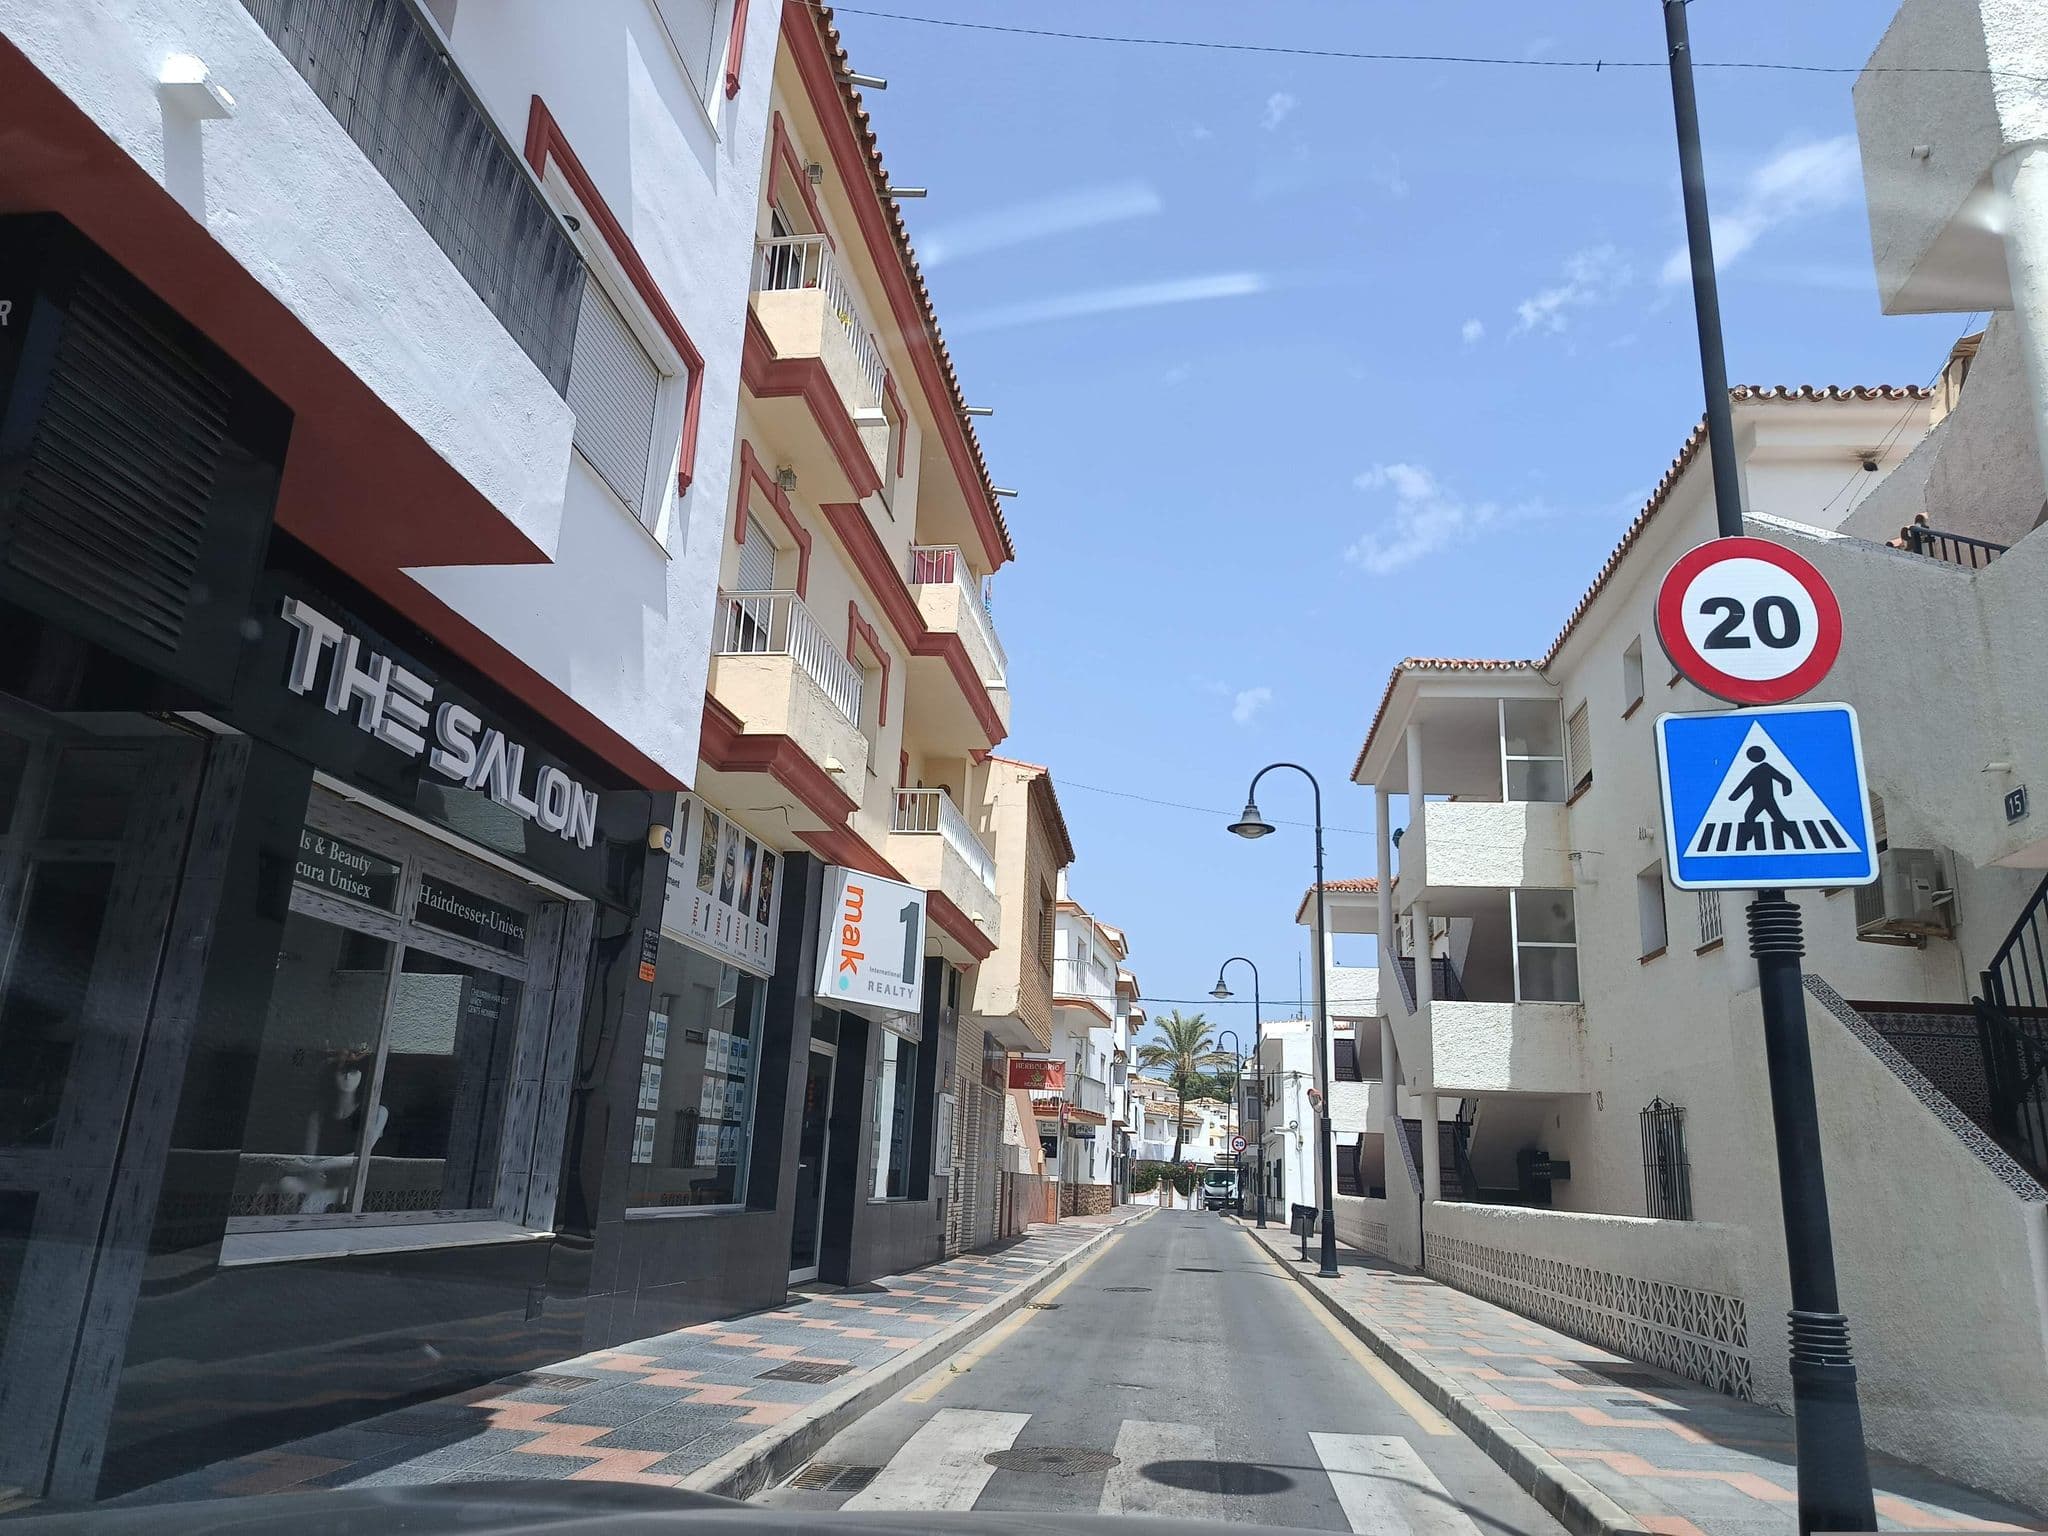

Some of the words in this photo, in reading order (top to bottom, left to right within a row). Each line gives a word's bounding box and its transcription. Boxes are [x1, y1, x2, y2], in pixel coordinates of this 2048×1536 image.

[1699, 595, 1801, 650] 20
[281, 595, 434, 757] THE
[430, 702, 599, 850] SALON
[2008, 794, 2022, 816] 15
[315, 836, 326, 856] &
[329, 841, 372, 876] Beauty
[329, 867, 372, 899] Unisex
[418, 883, 526, 939] Hairdresser-Unisex
[899, 900, 920, 986] 1
[868, 980, 914, 1000] REALTY
